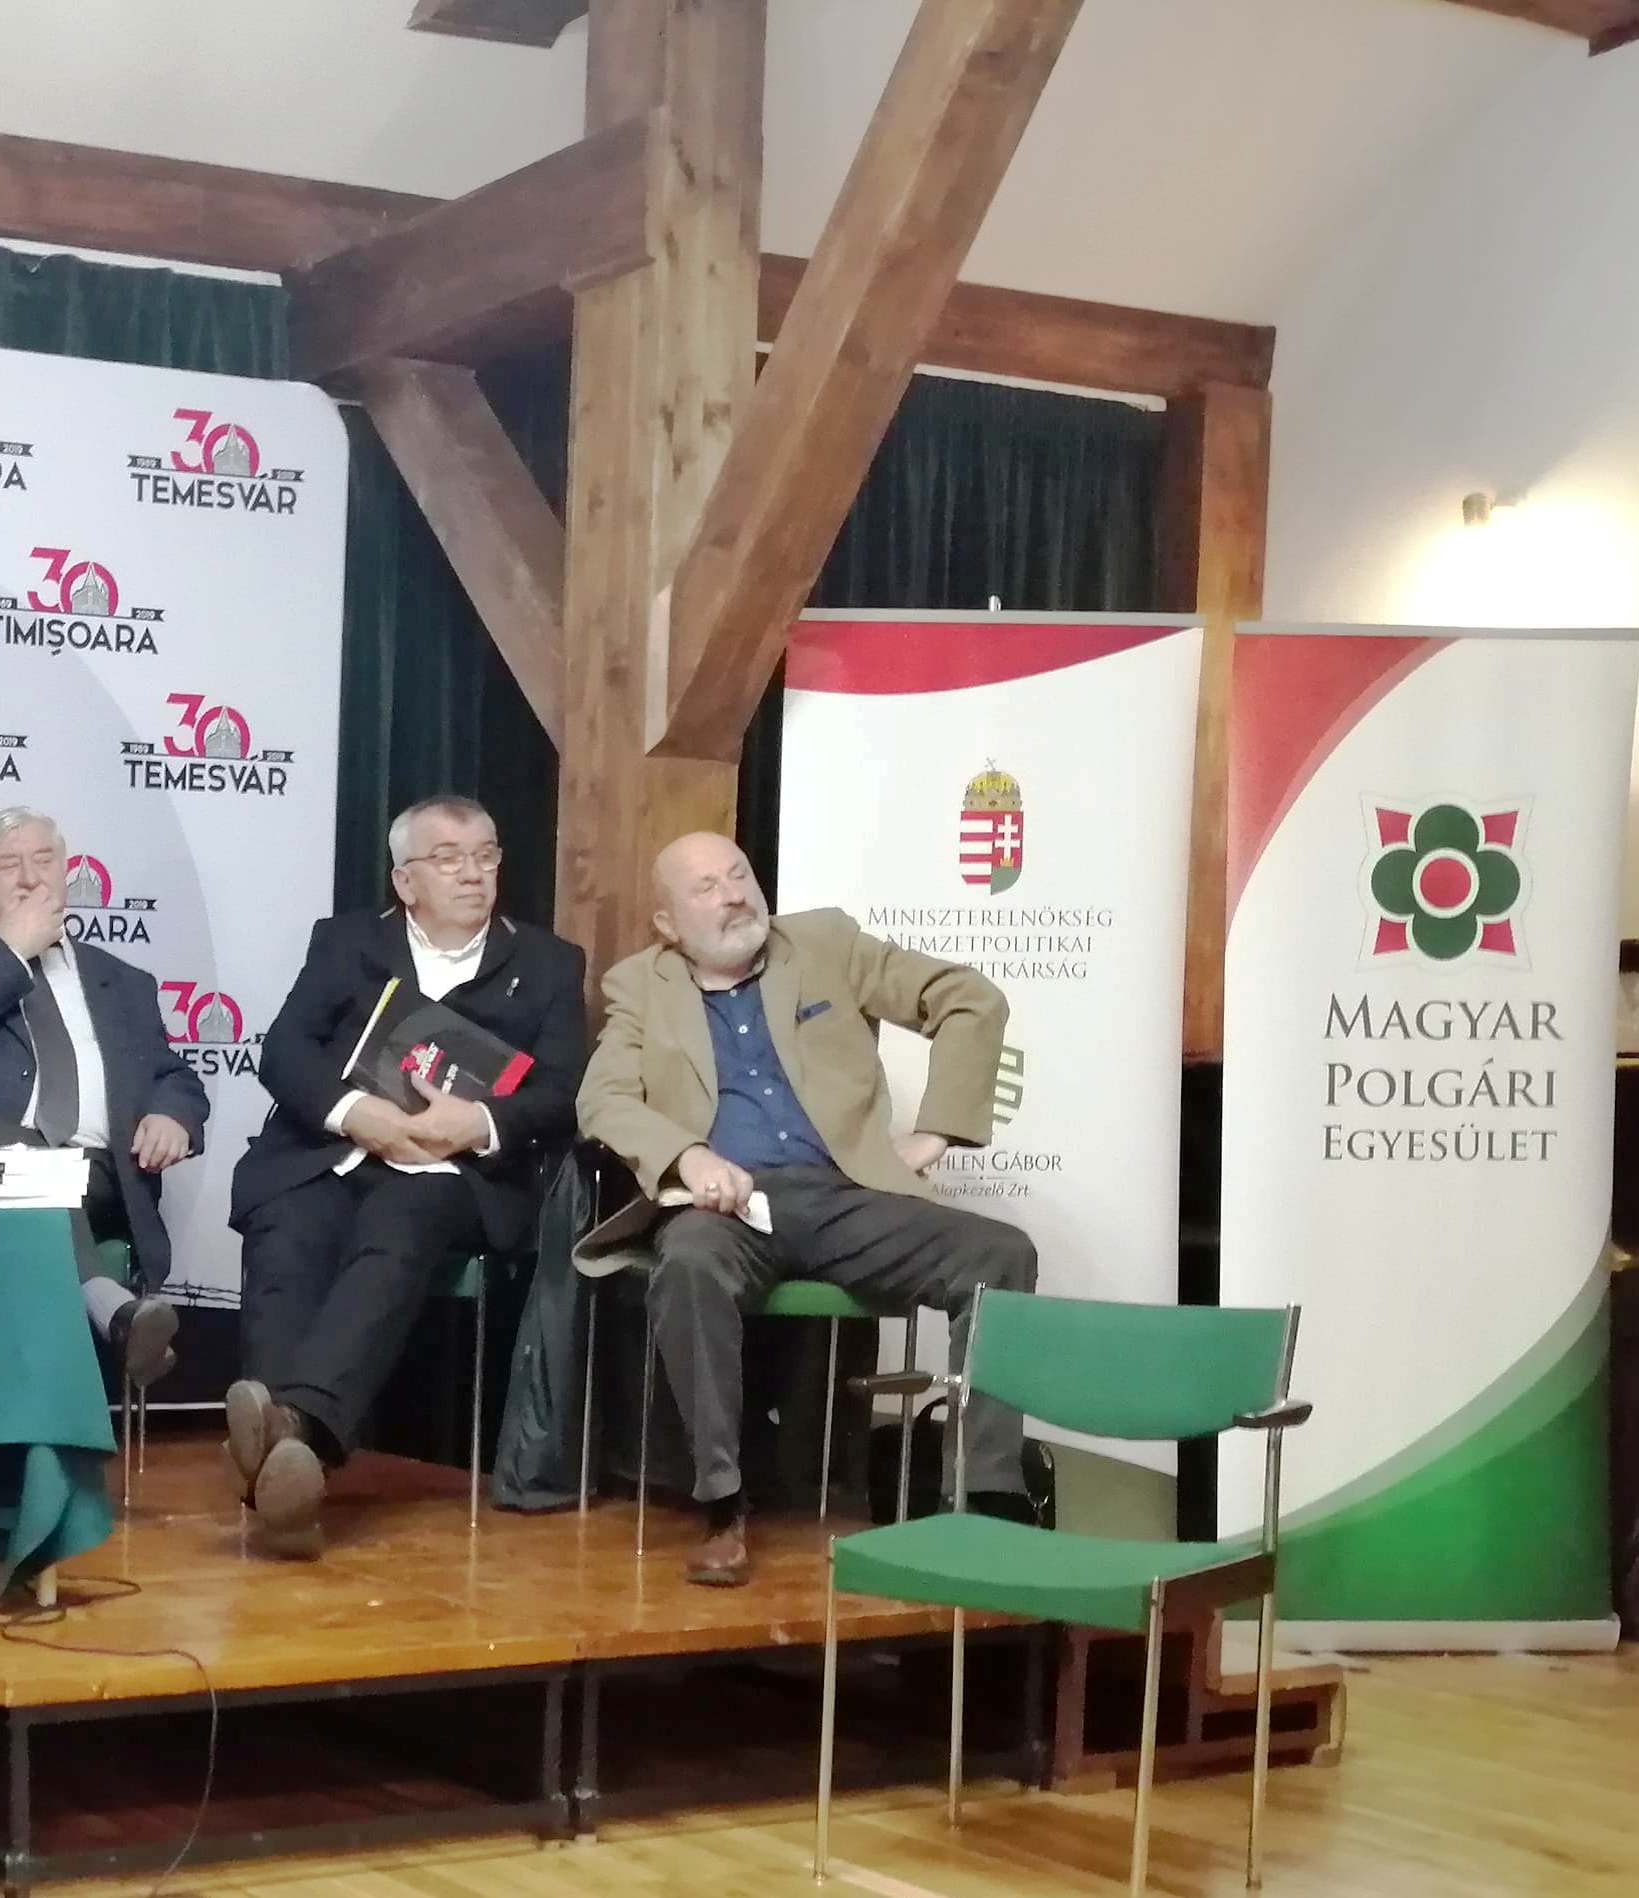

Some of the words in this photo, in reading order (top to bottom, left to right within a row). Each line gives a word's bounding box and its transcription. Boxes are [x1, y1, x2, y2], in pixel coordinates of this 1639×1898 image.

[129, 472, 297, 515] TEMESVÁR
[123, 755, 288, 796] TEMESVÁR
[867, 906, 1113, 927] MINISZTERELNÖKSÉG
[886, 932, 1092, 953] NEMZETPOLITIKAI
[1323, 992, 1565, 1042] MAGYAR
[177, 1037, 259, 1077] ESVÁ
[1325, 1058, 1557, 1109] POLGÁRI
[991, 1149, 1064, 1173] GÁBOR
[1322, 1123, 1558, 1162] EGYESÜLET
